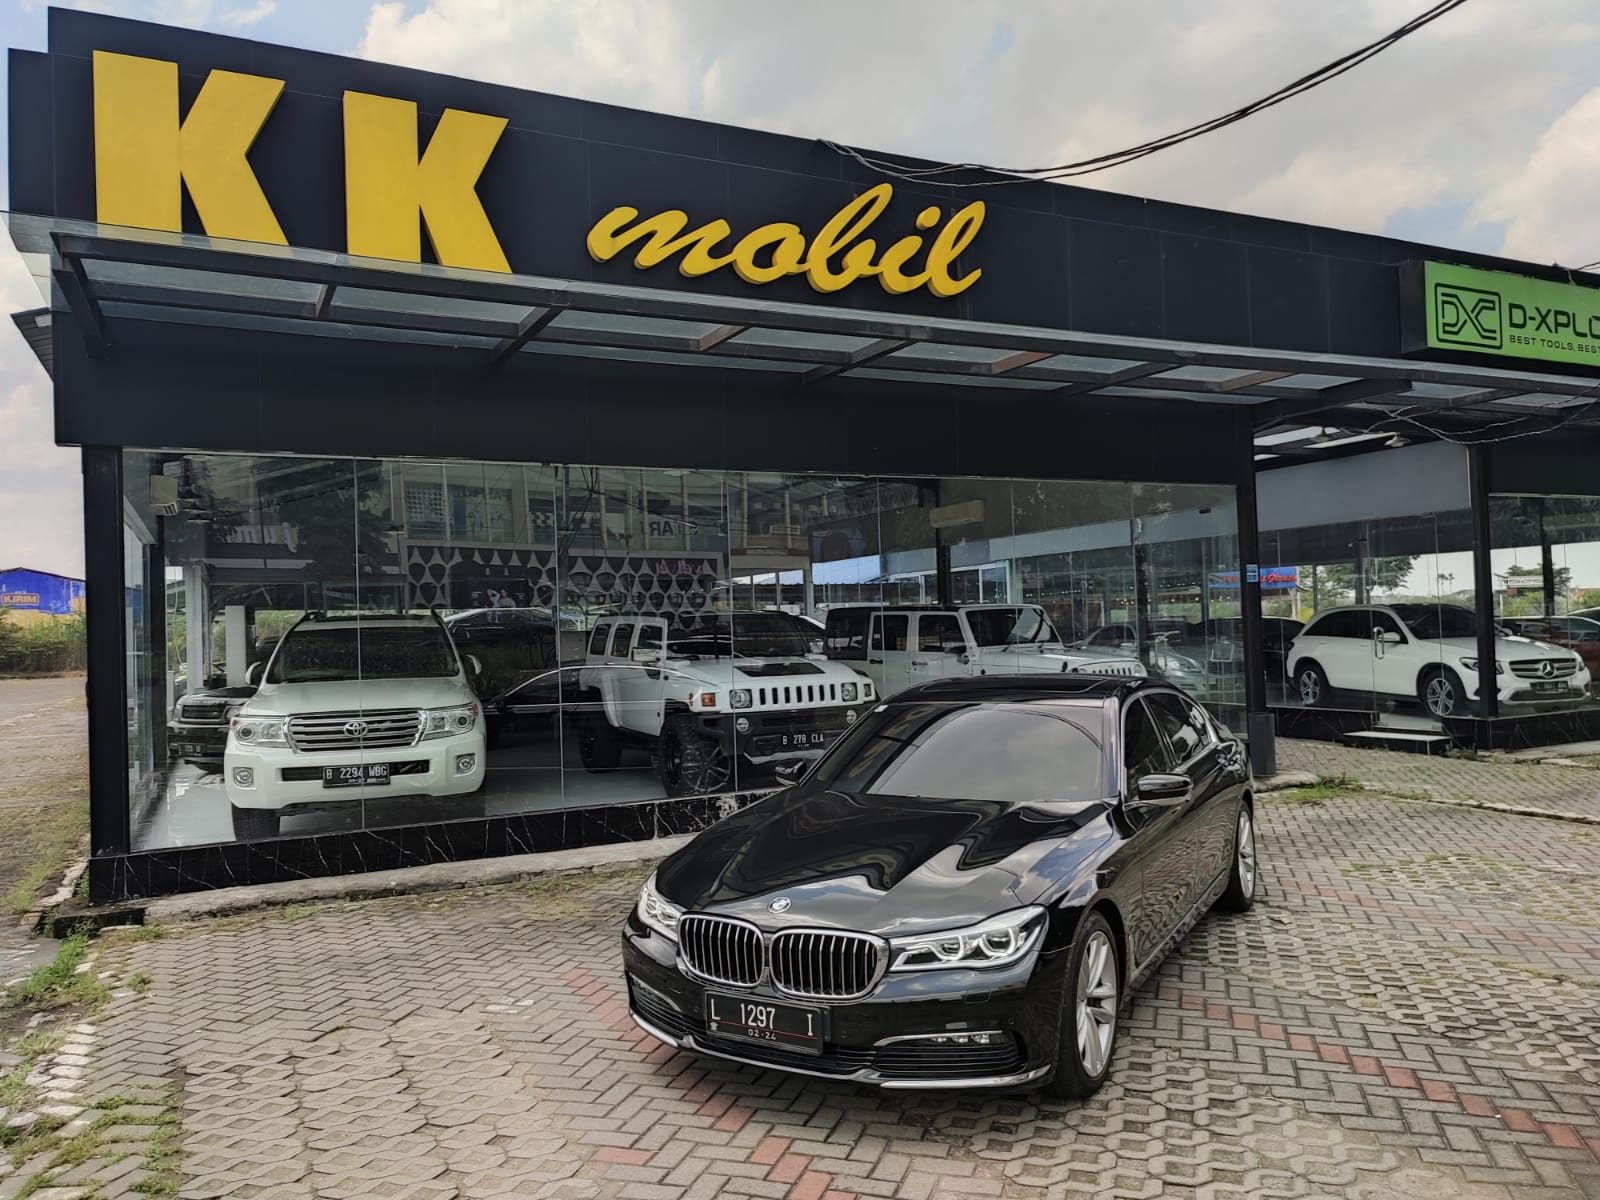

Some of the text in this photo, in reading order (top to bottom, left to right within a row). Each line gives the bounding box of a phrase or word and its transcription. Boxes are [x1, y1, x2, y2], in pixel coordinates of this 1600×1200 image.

[586, 183, 986, 297] mobil
[1509, 334, 1537, 345] BEST
[1540, 338, 1576, 353] TOOLS,
[783, 735, 788, 745] B
[326, 765, 387, 780] B 2294 WBG
[710, 998, 812, 1036] L 1297 I
